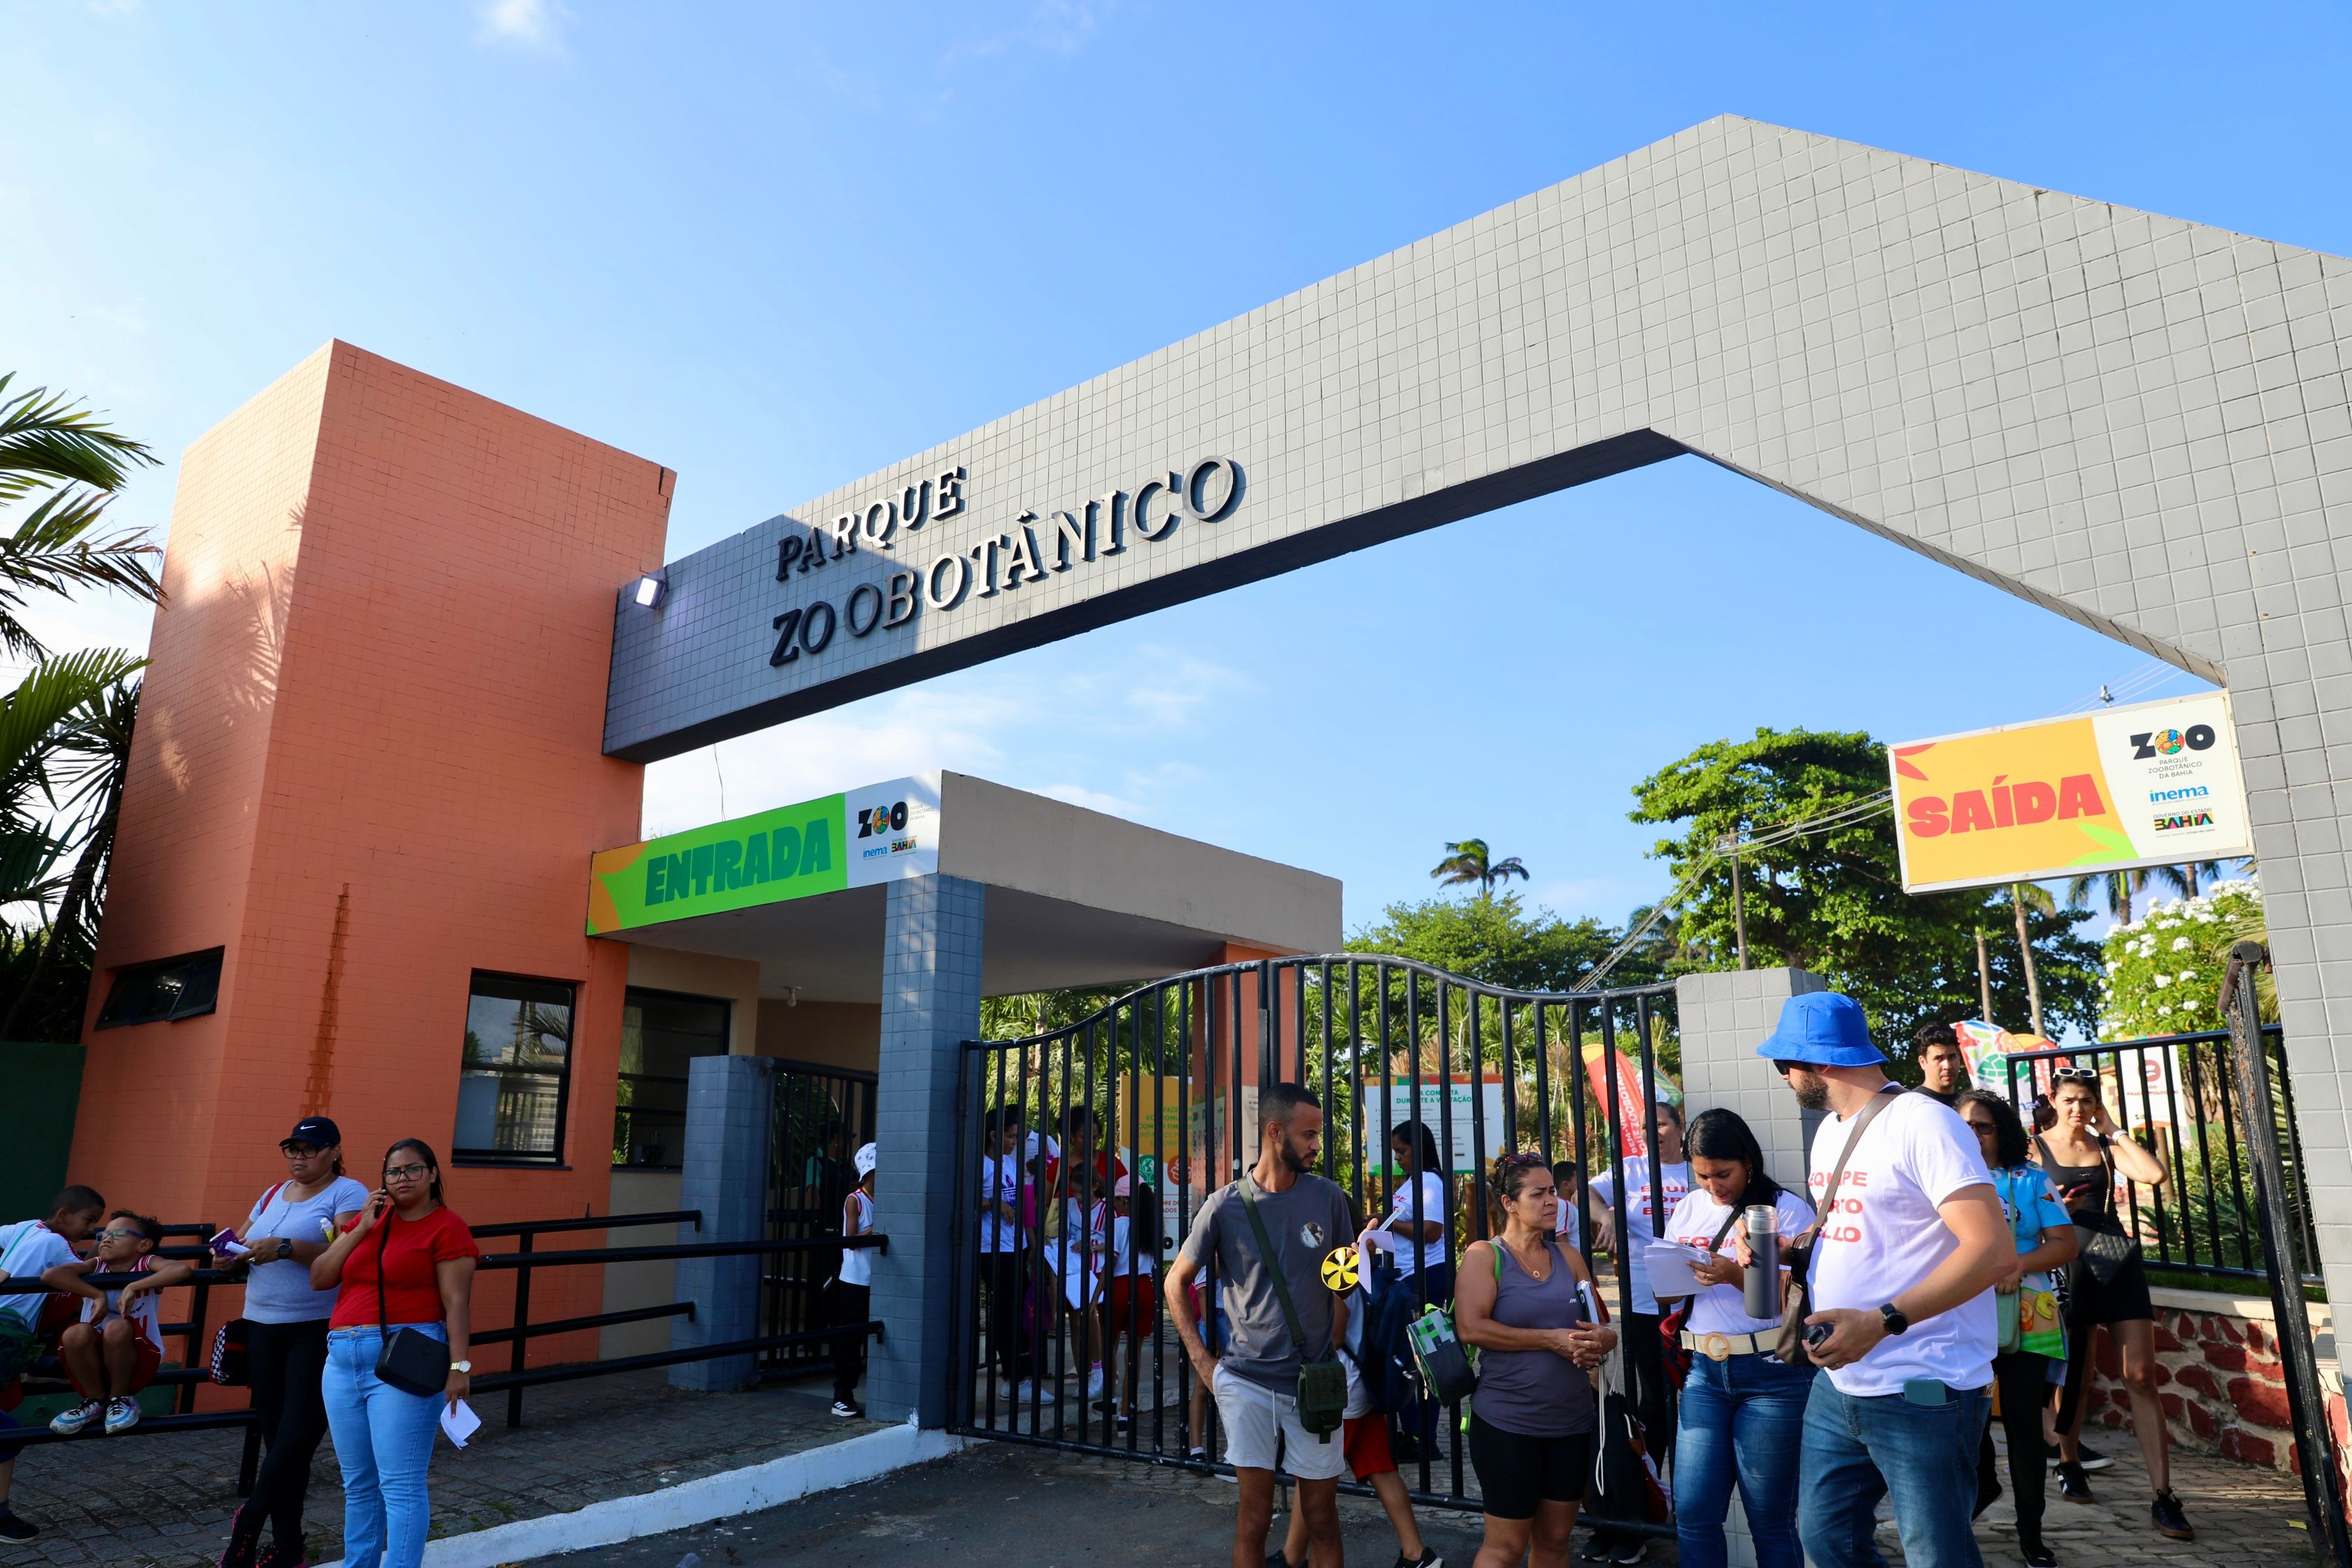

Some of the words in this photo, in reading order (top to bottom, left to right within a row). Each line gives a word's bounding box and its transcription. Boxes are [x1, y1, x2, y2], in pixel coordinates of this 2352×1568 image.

[775, 465, 966, 582] PARQUE
[770, 455, 1243, 667] ZOOBOTÂNICO
[2130, 724, 2216, 760] ZOO
[2148, 761, 2203, 774] ZOOBOTÂNICO
[2159, 756, 2189, 765] PARQUE
[2171, 769, 2193, 778] BAHIA
[1907, 774, 2106, 838] SAÍDA
[2149, 785, 2209, 802] inema
[858, 801, 909, 839] ZOO
[2153, 813, 2213, 831] BAHIA
[645, 818, 832, 906] ENTRADA
[862, 846, 888, 858] inema
